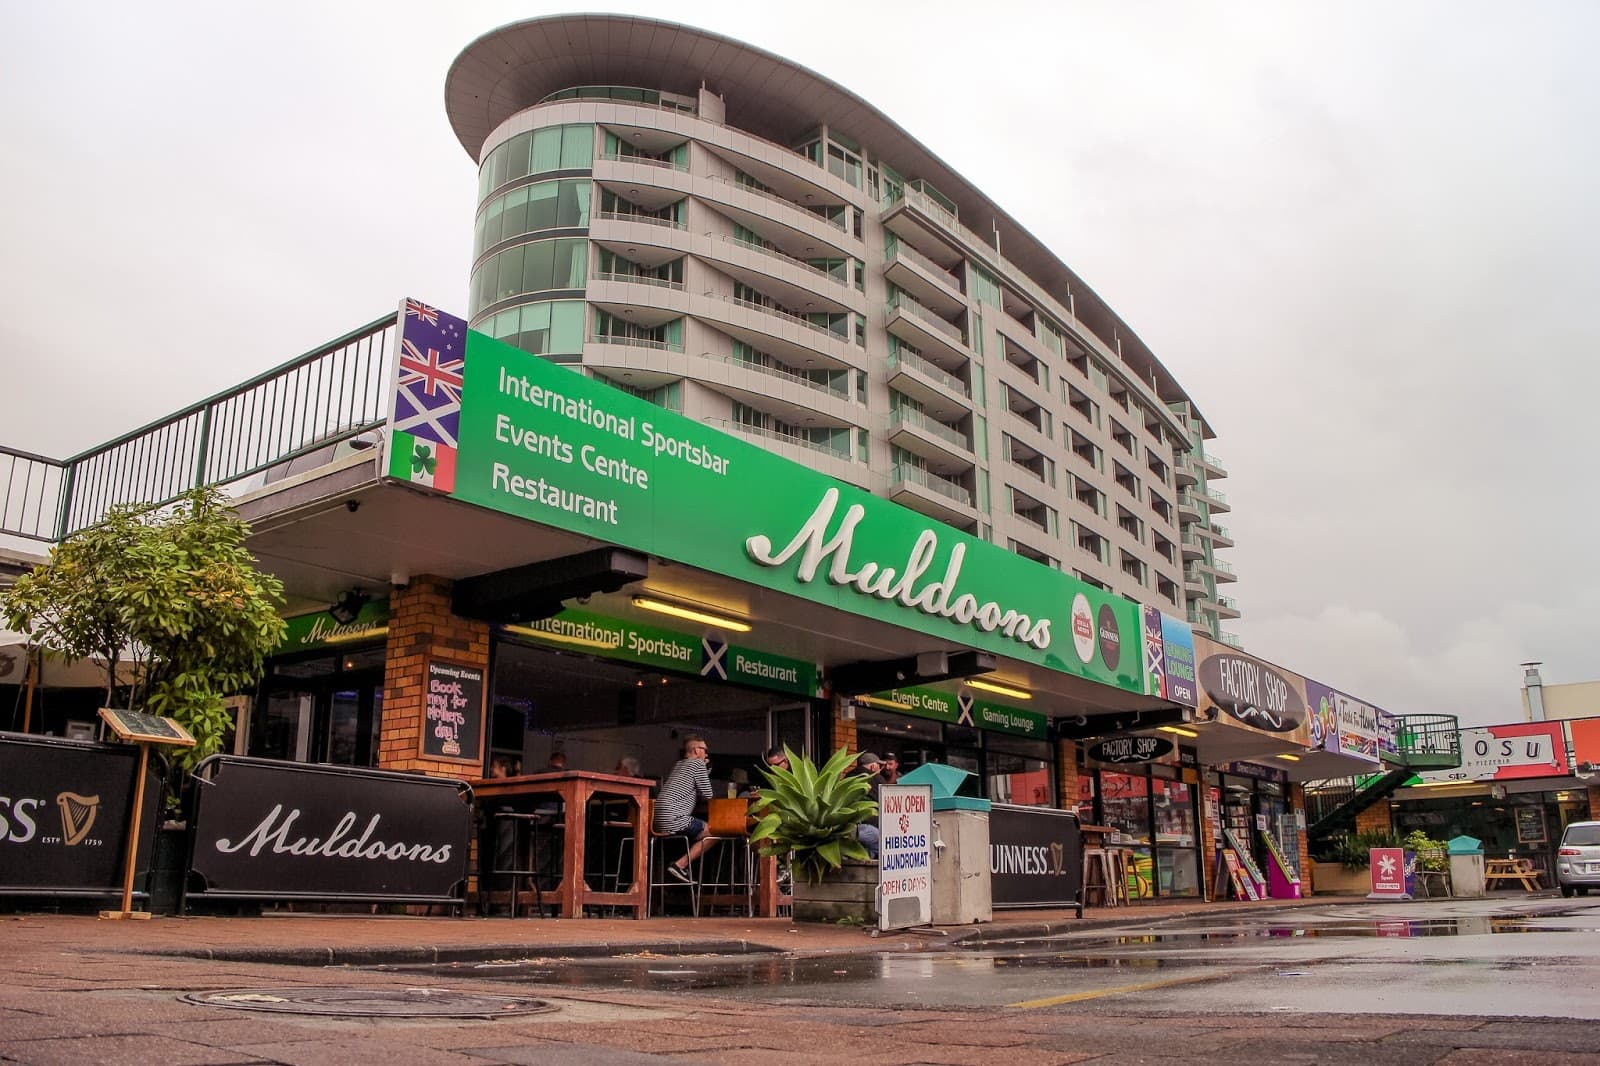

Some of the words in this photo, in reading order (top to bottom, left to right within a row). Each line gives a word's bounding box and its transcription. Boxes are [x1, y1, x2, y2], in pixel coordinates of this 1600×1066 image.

[499, 366, 635, 440] International
[641, 422, 730, 476] Sportsbar
[495, 414, 573, 464] Events
[581, 445, 649, 490] Centre
[492, 462, 618, 525] Restaurant
[745, 487, 1051, 649] Muldoons
[628, 631, 693, 662] Sportsbar
[1165, 641, 1193, 663] GAMING
[430, 664, 460, 679] Upcoming
[460, 670, 480, 680] Events
[736, 655, 797, 683] Restaurant
[1167, 658, 1194, 682] LOUNGE
[431, 680, 463, 695] Book
[1174, 684, 1191, 700] OPEN
[1219, 658, 1261, 707] FACTORY
[1265, 671, 1288, 712] SHOP
[451, 695, 468, 709] for
[892, 688, 920, 708] Events
[922, 695, 949, 713] Centre
[982, 707, 1009, 728] Gaming
[1010, 713, 1034, 732] Lounge
[1102, 739, 1133, 756] FACTORY
[1137, 738, 1157, 753] SHOP
[884, 796, 901, 814] NOW
[905, 796, 926, 813] OPEN
[215, 804, 452, 864] Muldoons
[885, 835, 926, 849] HIBISCUS
[883, 852, 928, 871] LAUNDROMAT
[882, 880, 901, 896] OPEN
[901, 879, 907, 892] 6
[908, 877, 927, 892] DAYS
